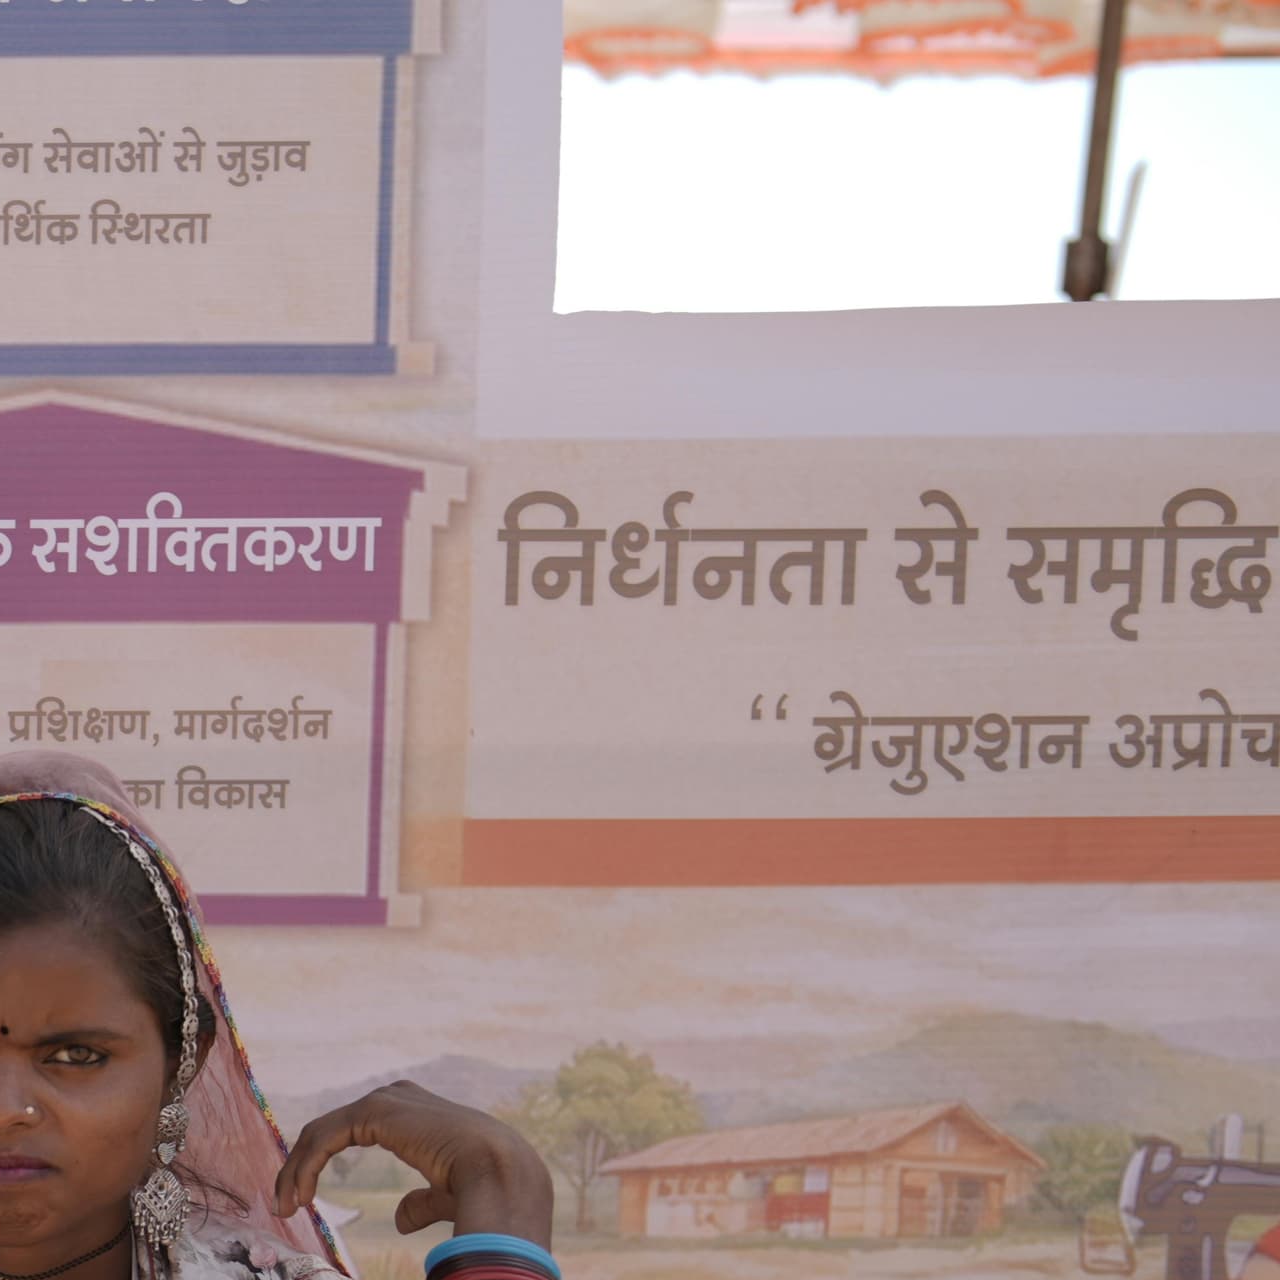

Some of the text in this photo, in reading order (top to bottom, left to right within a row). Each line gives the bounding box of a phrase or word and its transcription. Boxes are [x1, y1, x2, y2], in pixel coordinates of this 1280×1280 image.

[42, 127, 166, 174] सेवाओं
[172, 126, 206, 173] से
[216, 140, 311, 187] जुड़ाव
[88, 198, 212, 245] स्थिरता
[30, 491, 382, 575] सशक्तिकरण
[496, 487, 1280, 642] निर्धनता से समृद्धि
[8, 696, 160, 747] प्रशिक्षण,
[173, 695, 333, 743] मार्गदर्शन
[174, 765, 290, 810] विकास
